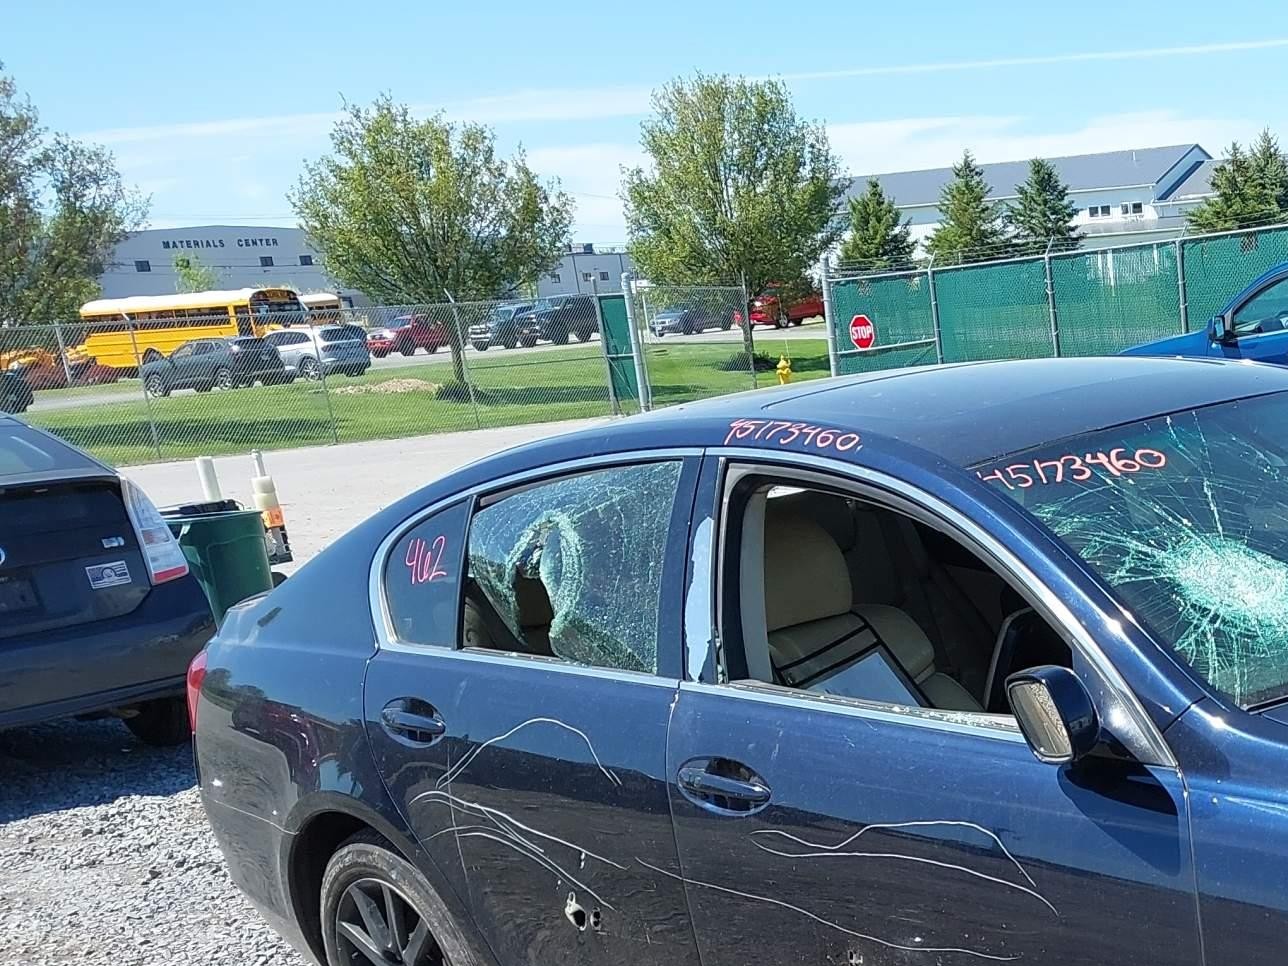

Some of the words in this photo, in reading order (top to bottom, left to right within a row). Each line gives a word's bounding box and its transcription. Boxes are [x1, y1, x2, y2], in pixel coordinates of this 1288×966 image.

[162, 240, 225, 249] MATERIALS
[237, 238, 279, 248] CENTER
[852, 325, 872, 340] STOP
[405, 535, 448, 585] 462
